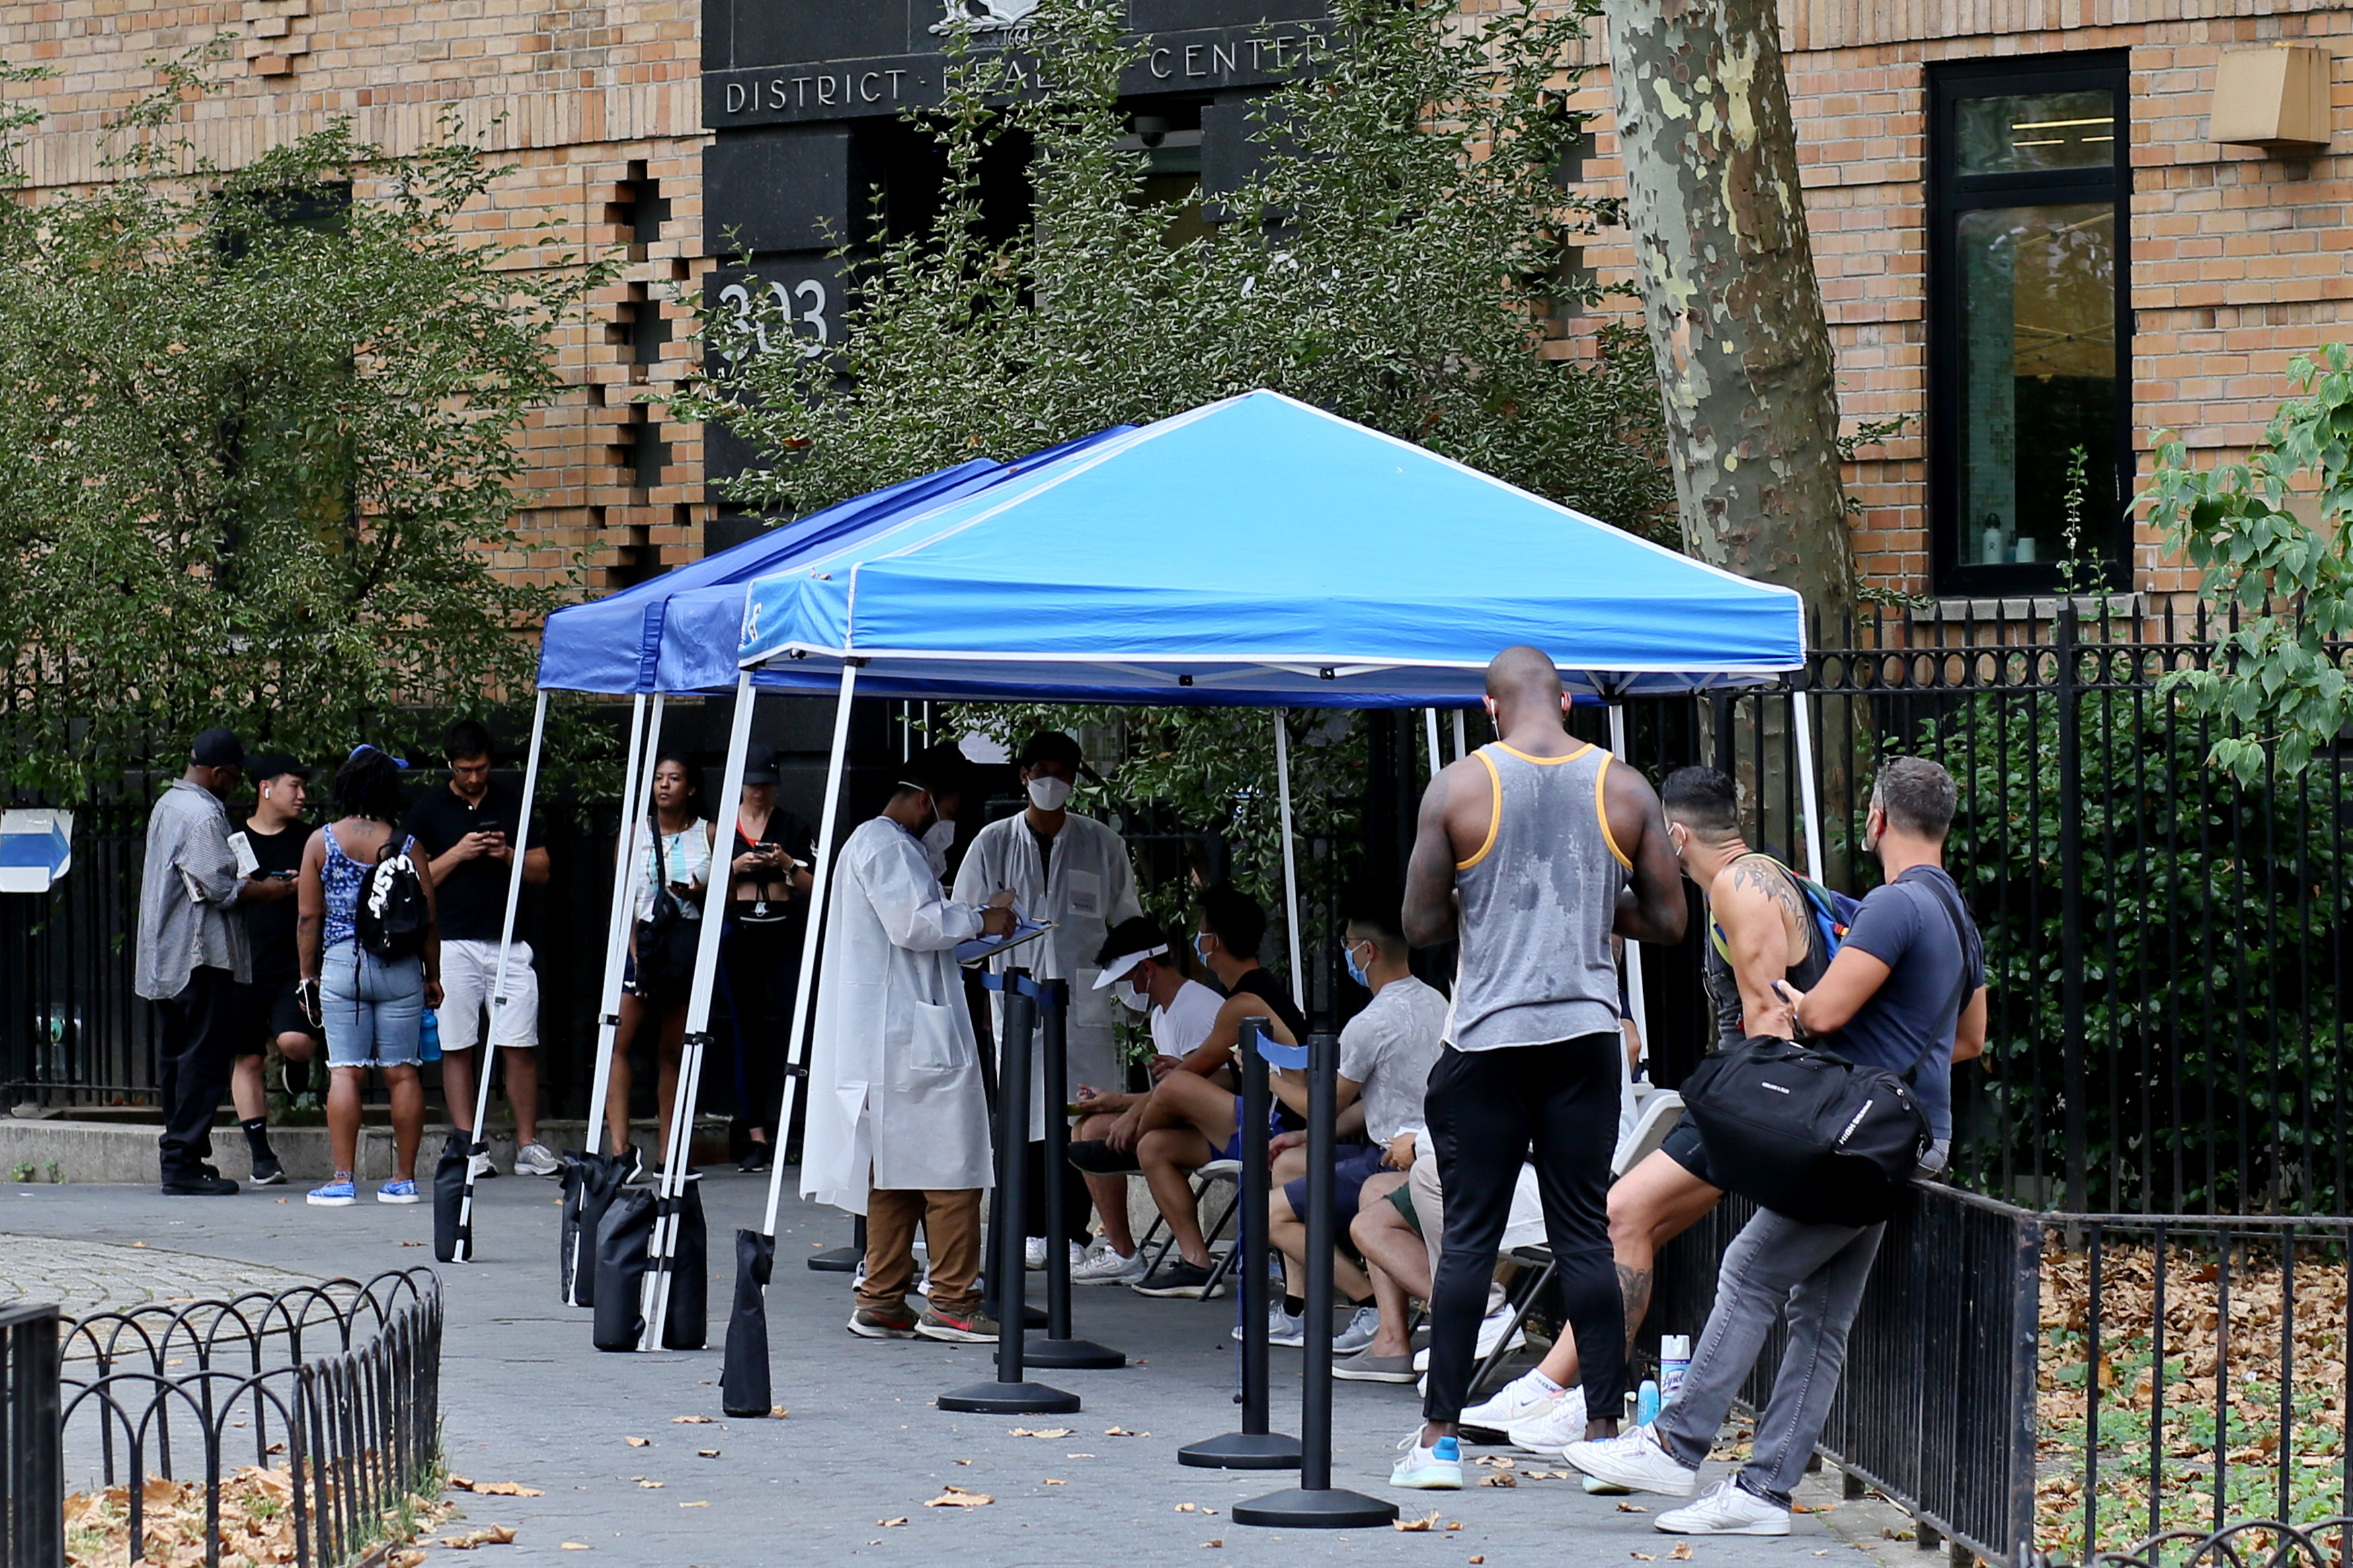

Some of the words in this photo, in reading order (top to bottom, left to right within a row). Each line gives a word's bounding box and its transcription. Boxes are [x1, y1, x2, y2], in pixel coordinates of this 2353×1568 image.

[727, 69, 907, 113] DISTRICT
[943, 55, 1096, 95] HEAL
[1150, 34, 1326, 79] CENTER
[719, 279, 828, 362] 303
